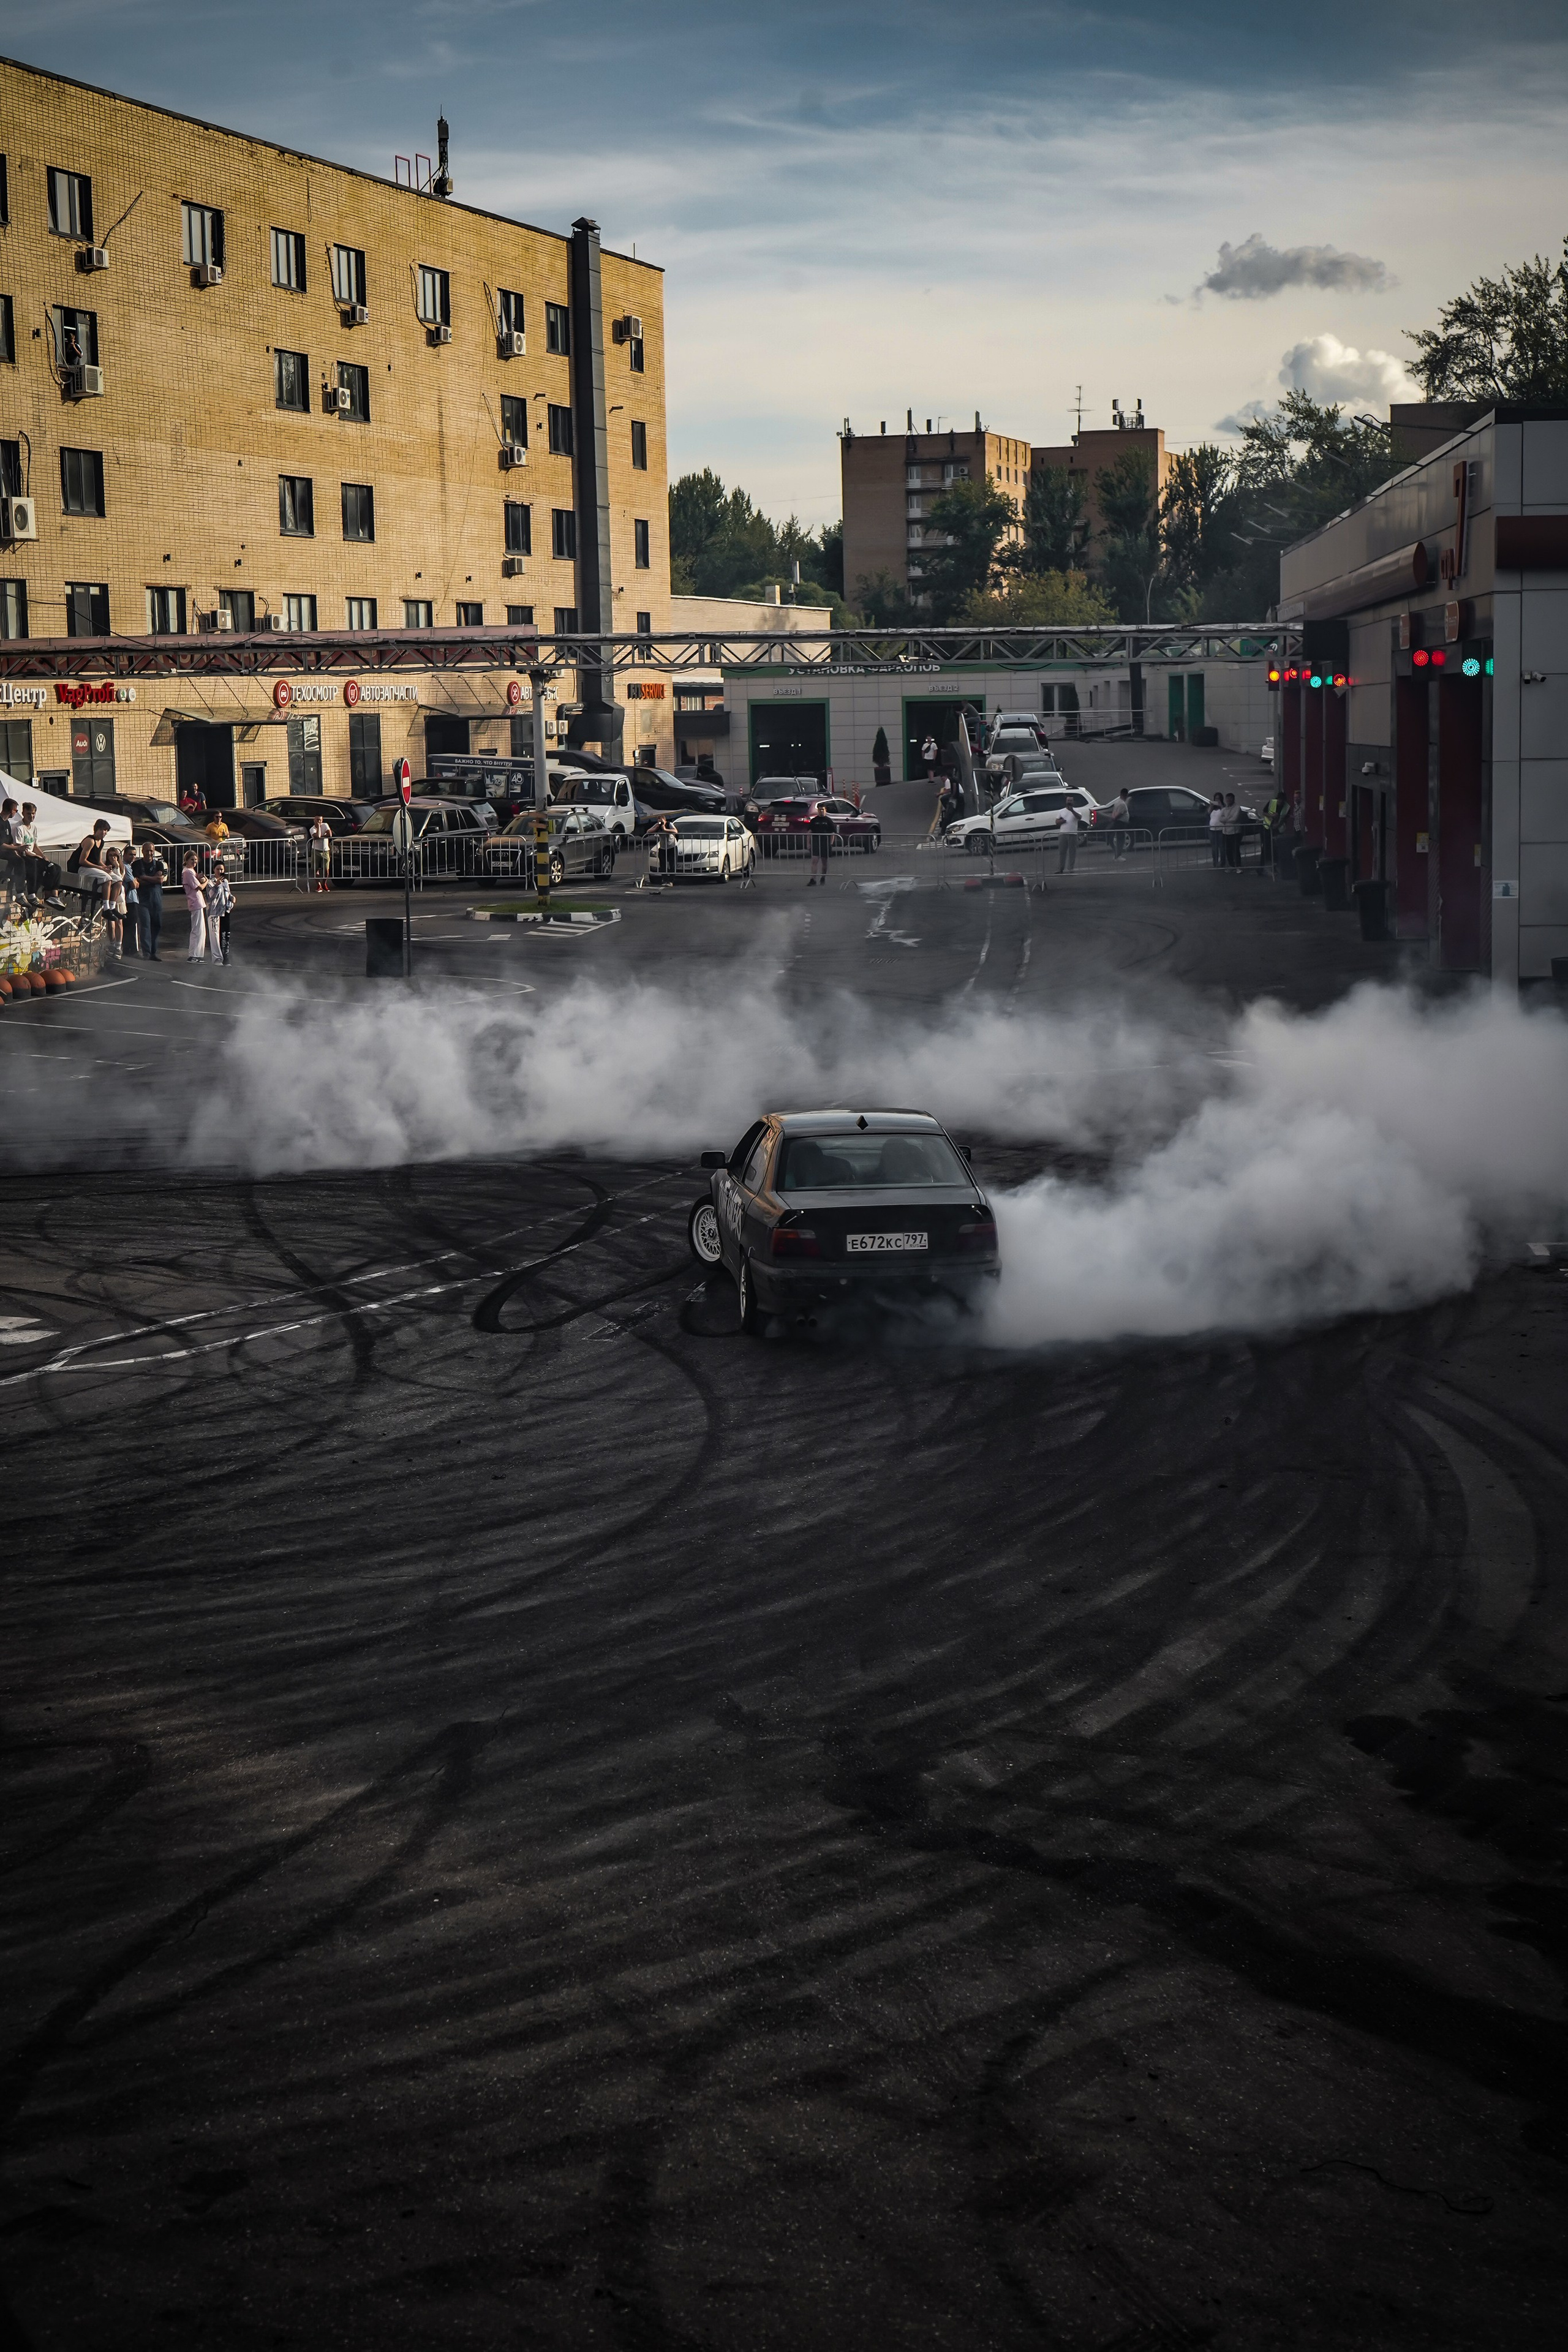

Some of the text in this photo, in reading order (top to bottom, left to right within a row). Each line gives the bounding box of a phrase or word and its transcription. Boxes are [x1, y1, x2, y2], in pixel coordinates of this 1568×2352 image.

[0, 683, 47, 708] Центр
[55, 682, 115, 707] VagProfi
[291, 685, 338, 701] ТЕХОСМОТР
[360, 685, 418, 701] АВТОЗАПЧАСТИ
[905, 1234, 924, 1244] 797
